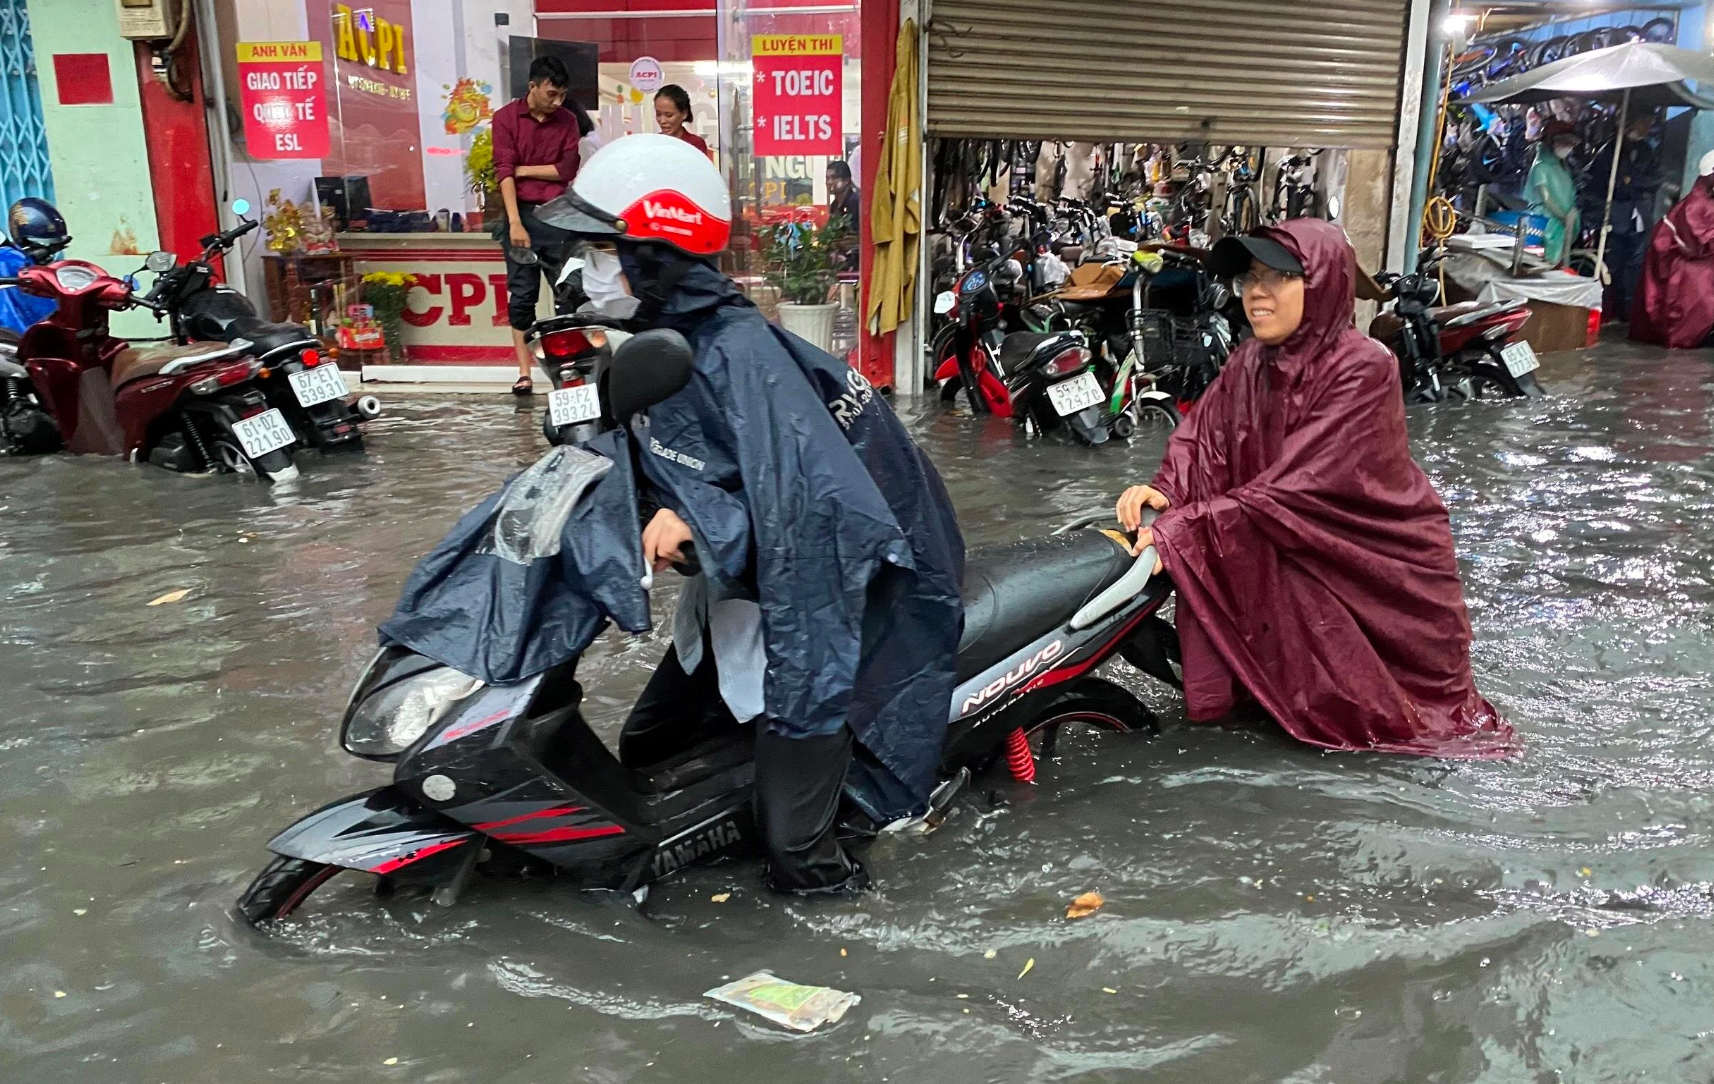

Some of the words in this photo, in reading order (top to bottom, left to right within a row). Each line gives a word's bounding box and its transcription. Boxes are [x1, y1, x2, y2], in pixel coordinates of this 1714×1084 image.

[252, 45, 277, 57] ANH
[281, 44, 307, 56] VĂN
[336, 3, 408, 74] ACPI
[762, 36, 806, 53] LUYỆN
[811, 39, 833, 50] THI
[247, 72, 280, 90] GIAO
[283, 65, 317, 90] TIẾP
[771, 70, 834, 96] TOEIC
[296, 95, 316, 120] TẾ
[773, 115, 832, 140] IELTS
[275, 133, 303, 151] ESL
[643, 200, 703, 225] VinMart
[400, 272, 512, 327] CPI
[297, 368, 334, 388] 67-E1
[300, 381, 344, 404] 539.31
[554, 387, 591, 407] 59-F2
[554, 402, 596, 423] 393.24
[246, 427, 291, 455] 221.90
[961, 640, 1062, 714] NOUVO
[651, 820, 741, 877] YAMAHA
